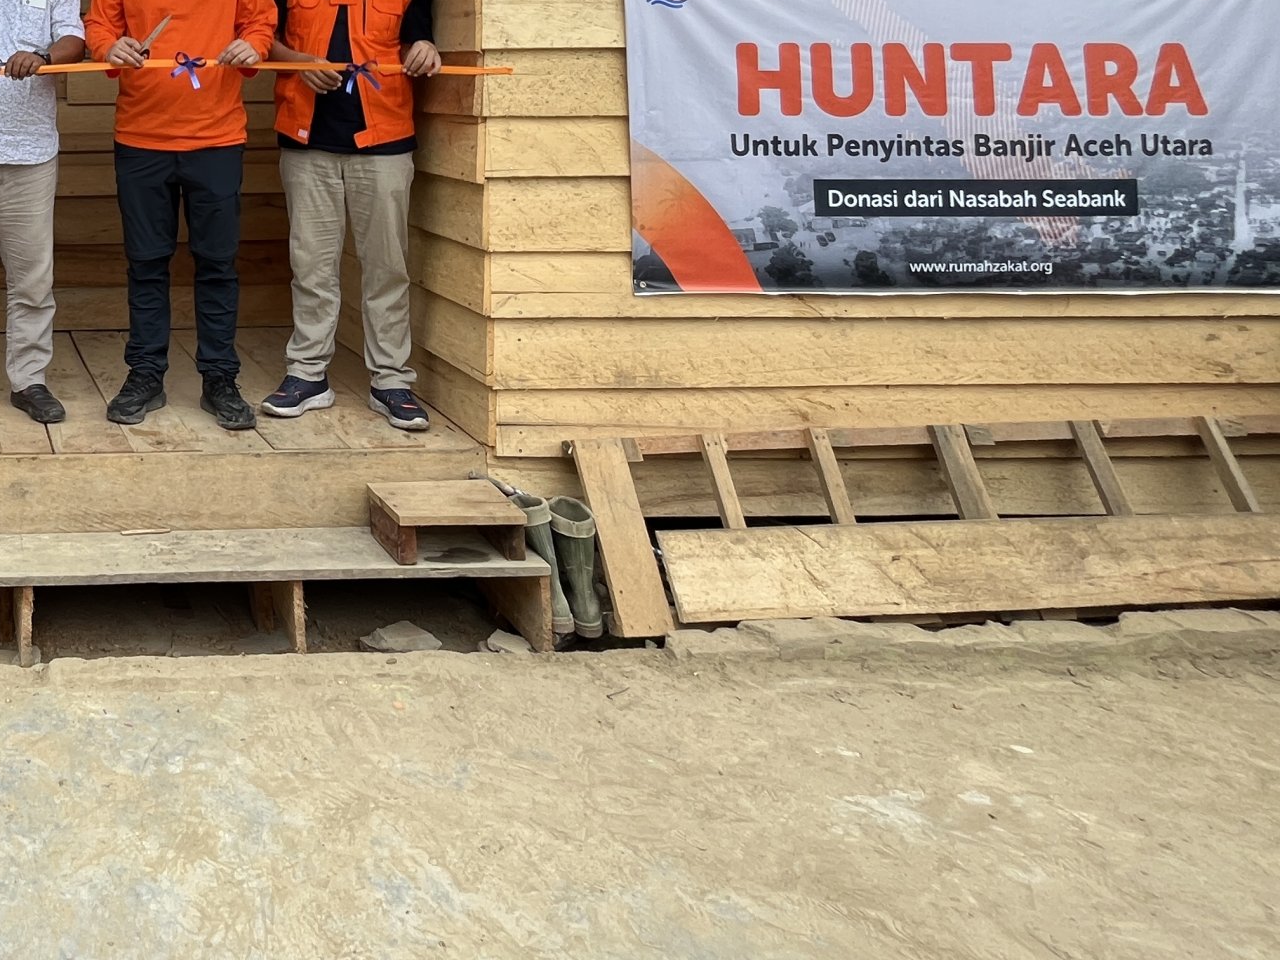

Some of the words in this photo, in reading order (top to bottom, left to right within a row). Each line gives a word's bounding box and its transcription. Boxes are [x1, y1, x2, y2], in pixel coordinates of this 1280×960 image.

[735, 42, 1209, 117] HUNTARA
[730, 133, 819, 157] Untuk
[827, 133, 965, 163] Penyintas
[974, 133, 1056, 163] Banjir
[1064, 133, 1133, 157] Aceh
[1140, 133, 1214, 157] Utara
[827, 189, 899, 208] Donasi
[903, 189, 944, 208] dari
[949, 189, 1038, 208] Nasabah
[1042, 189, 1127, 208] Seabank
[909, 260, 1053, 275] www.rumahzakat.org
